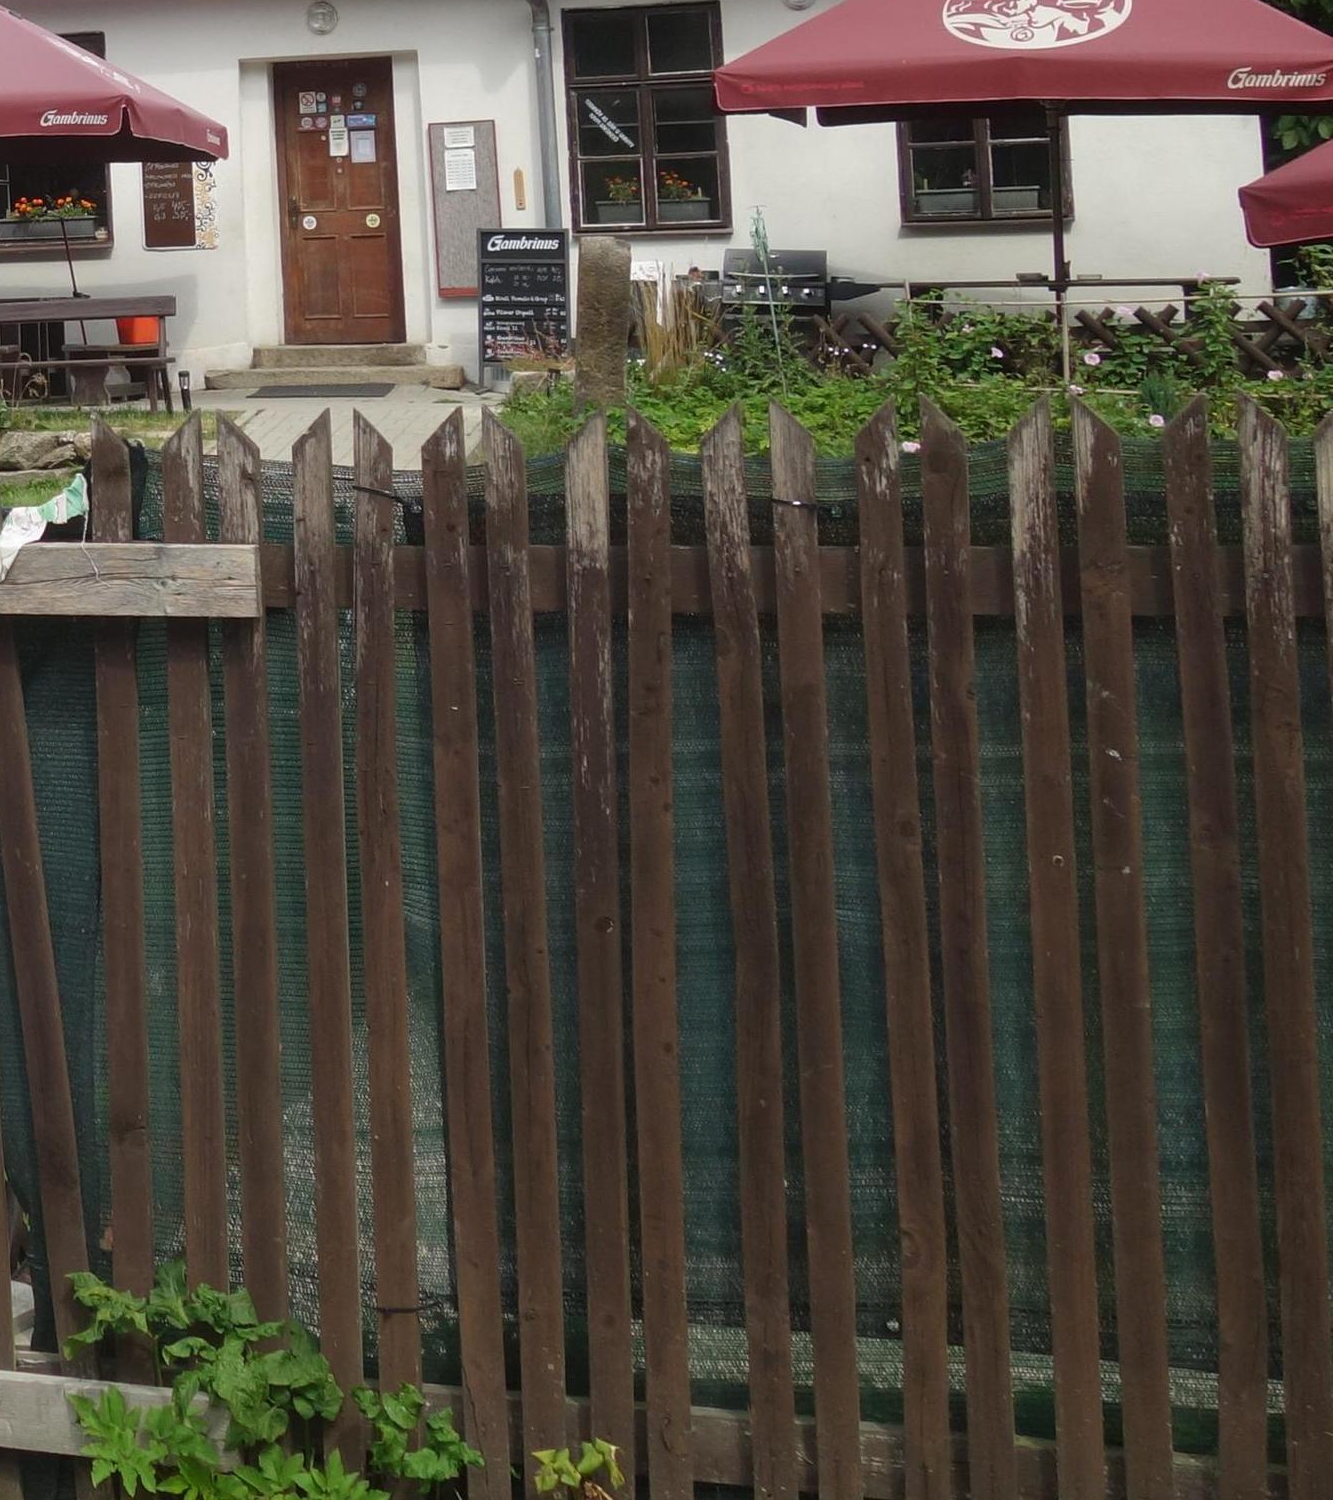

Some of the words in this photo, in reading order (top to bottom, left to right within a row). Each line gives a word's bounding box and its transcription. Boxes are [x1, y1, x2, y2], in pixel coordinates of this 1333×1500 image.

[1227, 67, 1327, 89] Gambrinus
[40, 109, 108, 127] Gambrinus
[487, 234, 560, 252] Gambrinus
